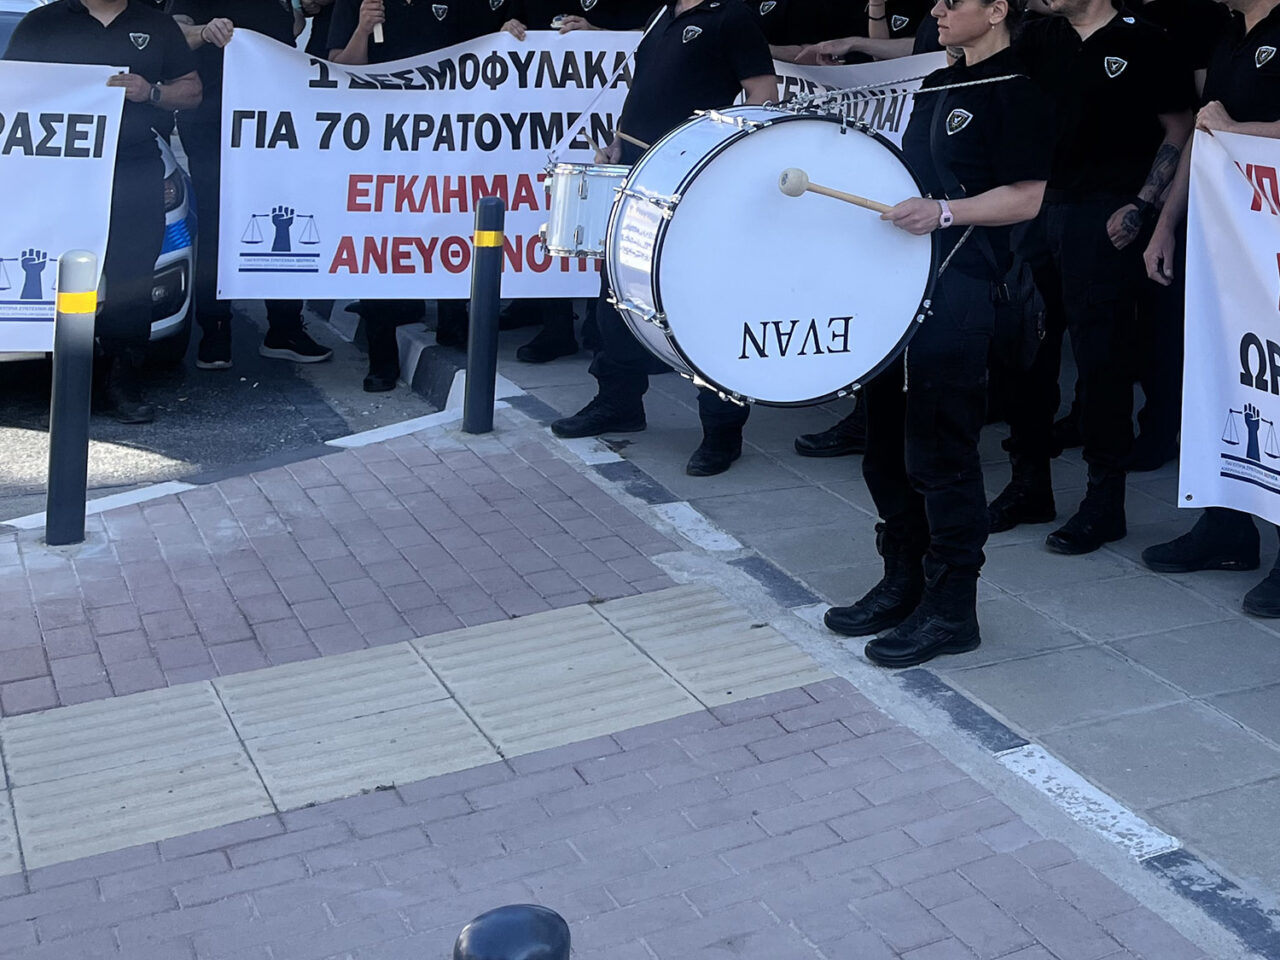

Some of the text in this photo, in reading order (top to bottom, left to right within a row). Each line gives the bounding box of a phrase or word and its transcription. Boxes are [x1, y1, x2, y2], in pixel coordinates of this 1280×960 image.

[309, 50, 638, 90] 1 ΔΕΣΜΟΦΥΛΑΚΑ
[231, 110, 617, 152] ΓΙΑ 70 ΚΡΑΤΟΥΜΕΝ
[328, 235, 601, 275] ΑΝΕΥΘΝΟ
[738, 316, 854, 359] EVAN
